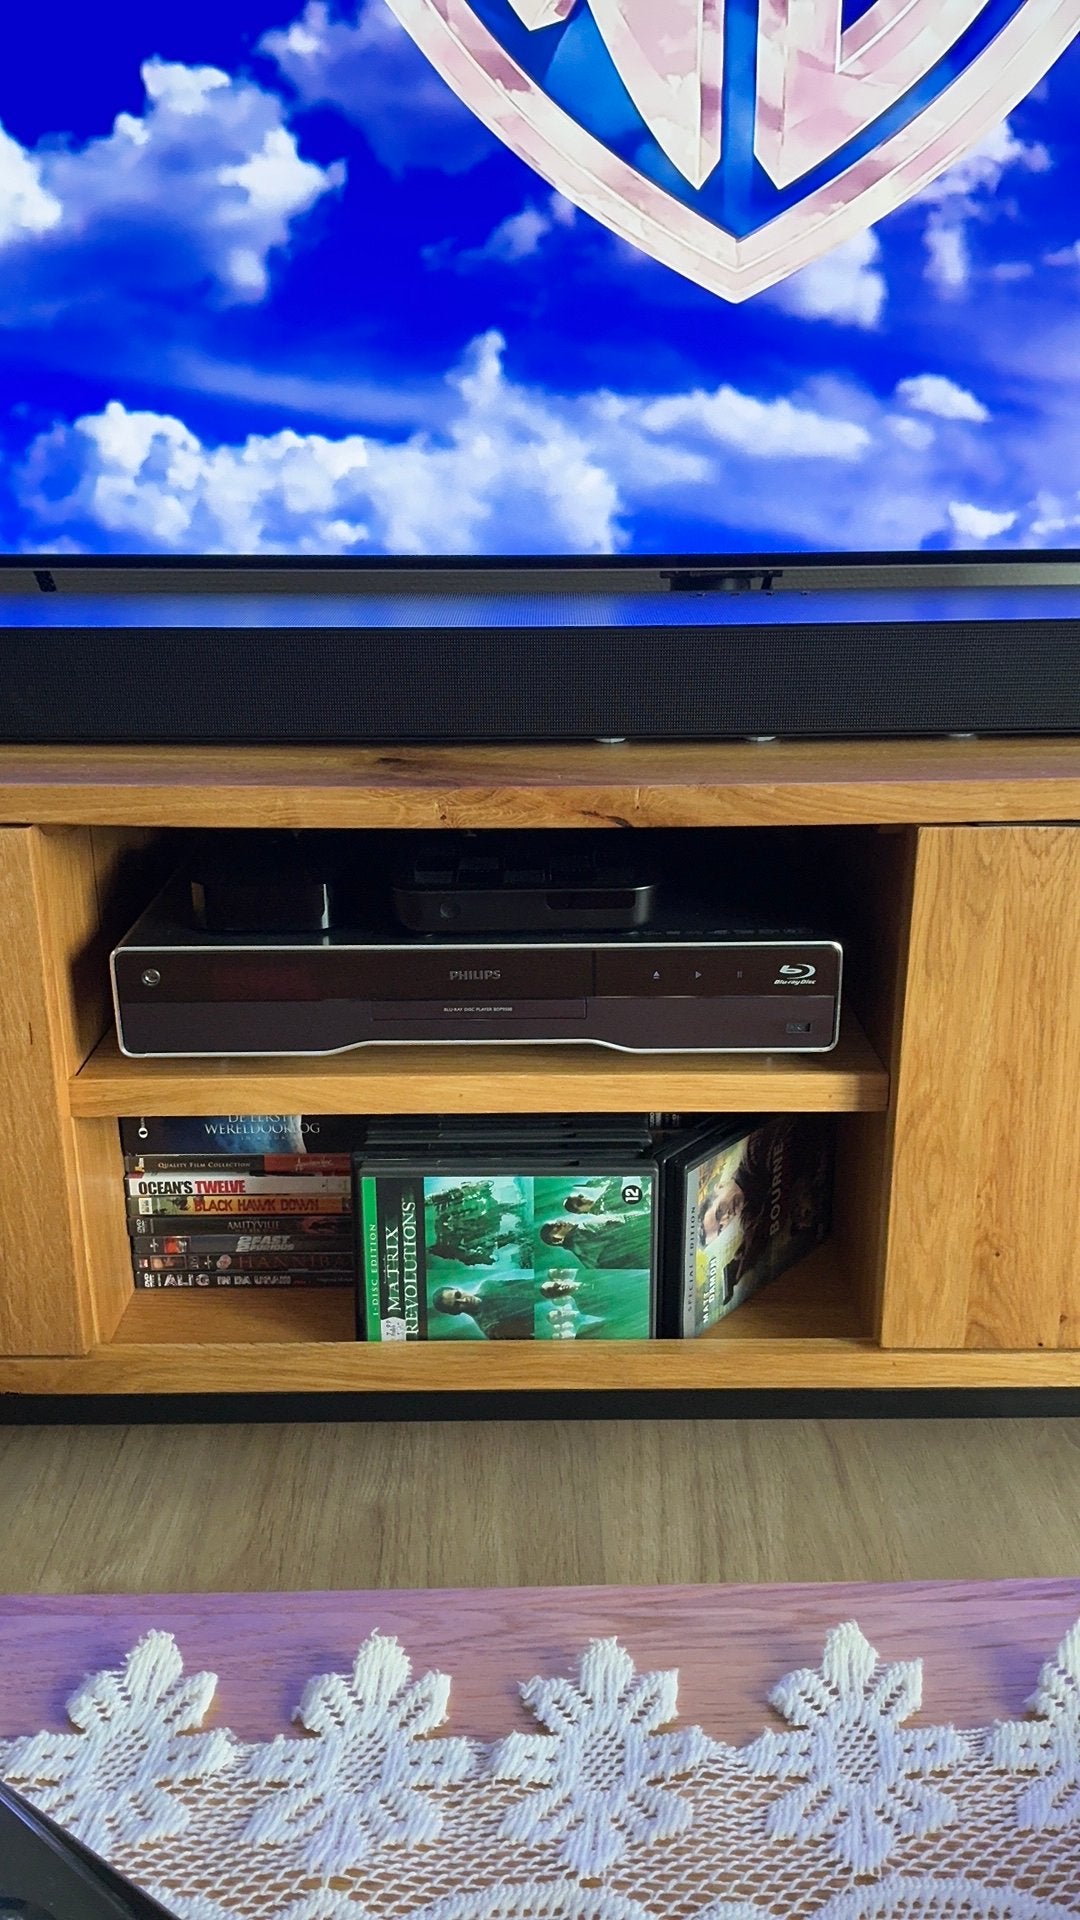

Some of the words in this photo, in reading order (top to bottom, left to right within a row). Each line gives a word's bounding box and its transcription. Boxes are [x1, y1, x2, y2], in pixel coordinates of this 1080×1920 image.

[449, 970, 501, 981] PHILIPS
[158, 1161, 188, 1169] QUALITY
[138, 1180, 193, 1195] OCEAN'S
[195, 1180, 246, 1194] TWELVE
[625, 1187, 640, 1202] 12
[769, 1139, 784, 1237] BOURNE
[194, 1198, 233, 1212] BLACK
[237, 1199, 276, 1211] HAWK
[280, 1199, 319, 1211] DOWN
[228, 1221, 280, 1230] AMITYVILLE
[689, 1206, 697, 1257] EDITION
[251, 1235, 290, 1245] FAST
[369, 1224, 378, 1273] EDITION
[385, 1227, 402, 1313] MATRIX
[402, 1201, 419, 1335] REVOLUTIONS
[195, 1273, 209, 1286] G
[708, 1257, 717, 1303] DAMON
[702, 1290, 710, 1324] MATT
